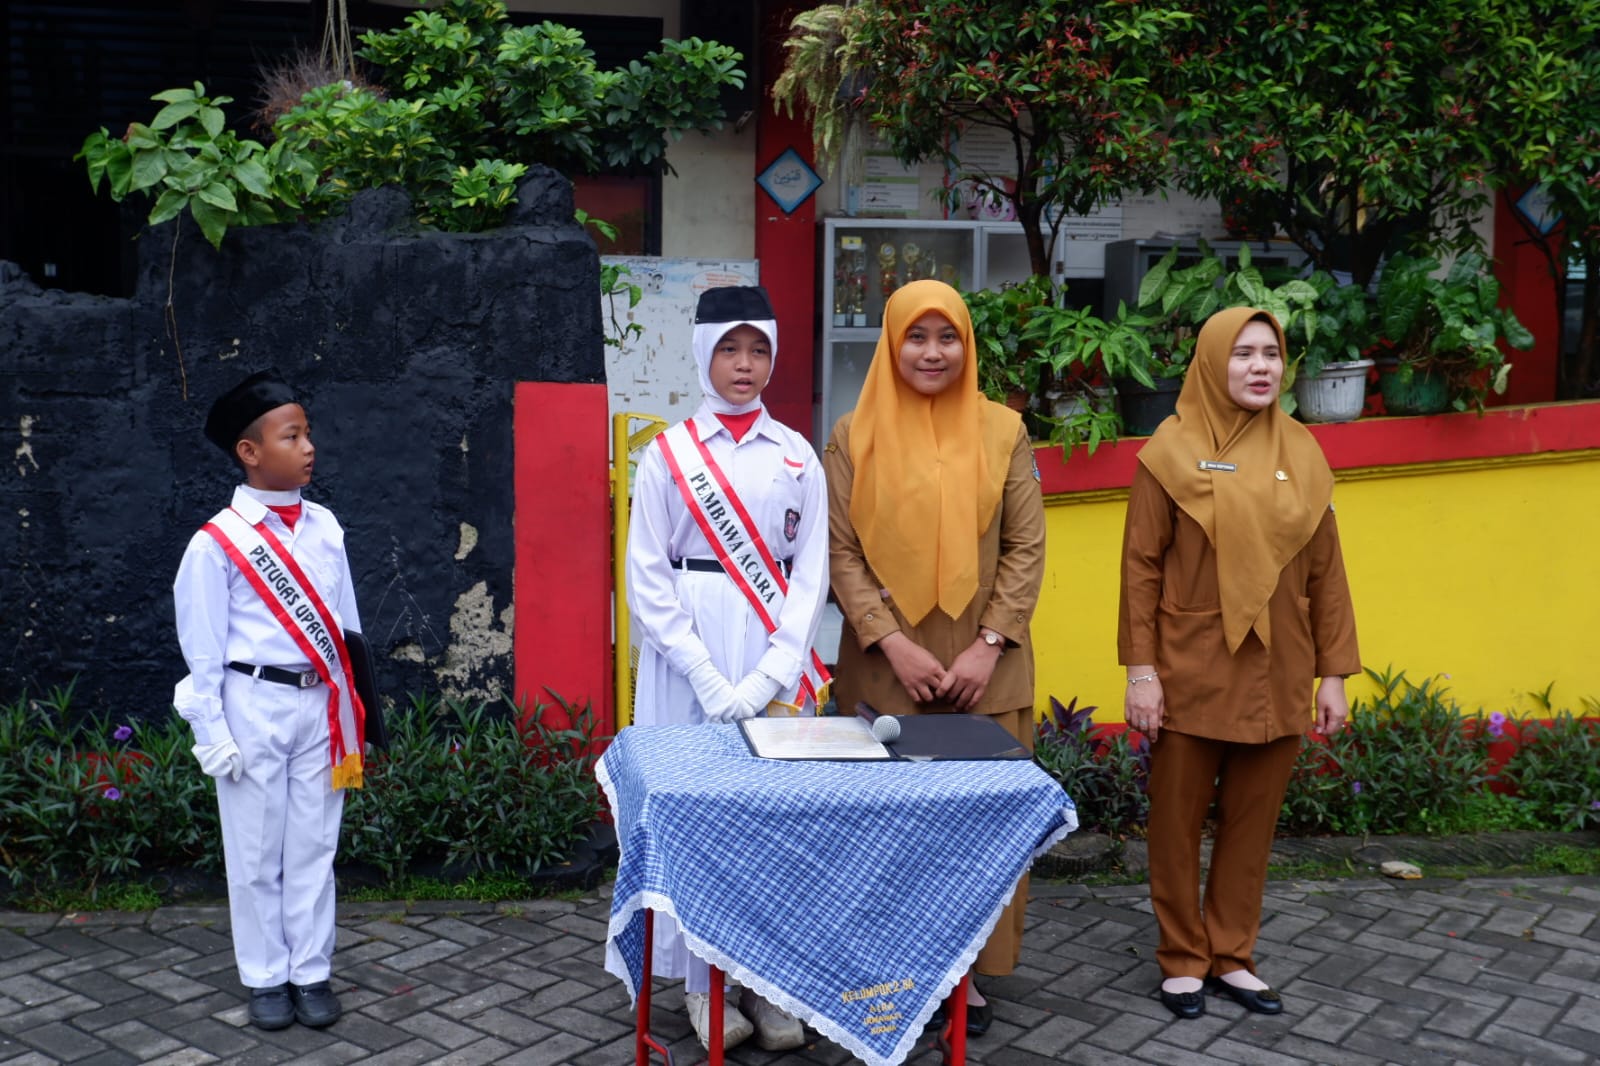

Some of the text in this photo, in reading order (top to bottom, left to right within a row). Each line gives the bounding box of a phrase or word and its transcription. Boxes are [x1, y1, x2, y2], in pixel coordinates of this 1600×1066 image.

[690, 472, 776, 604] PEMBAWA ACARA
[249, 545, 336, 666] PETUGAS UPACARA
